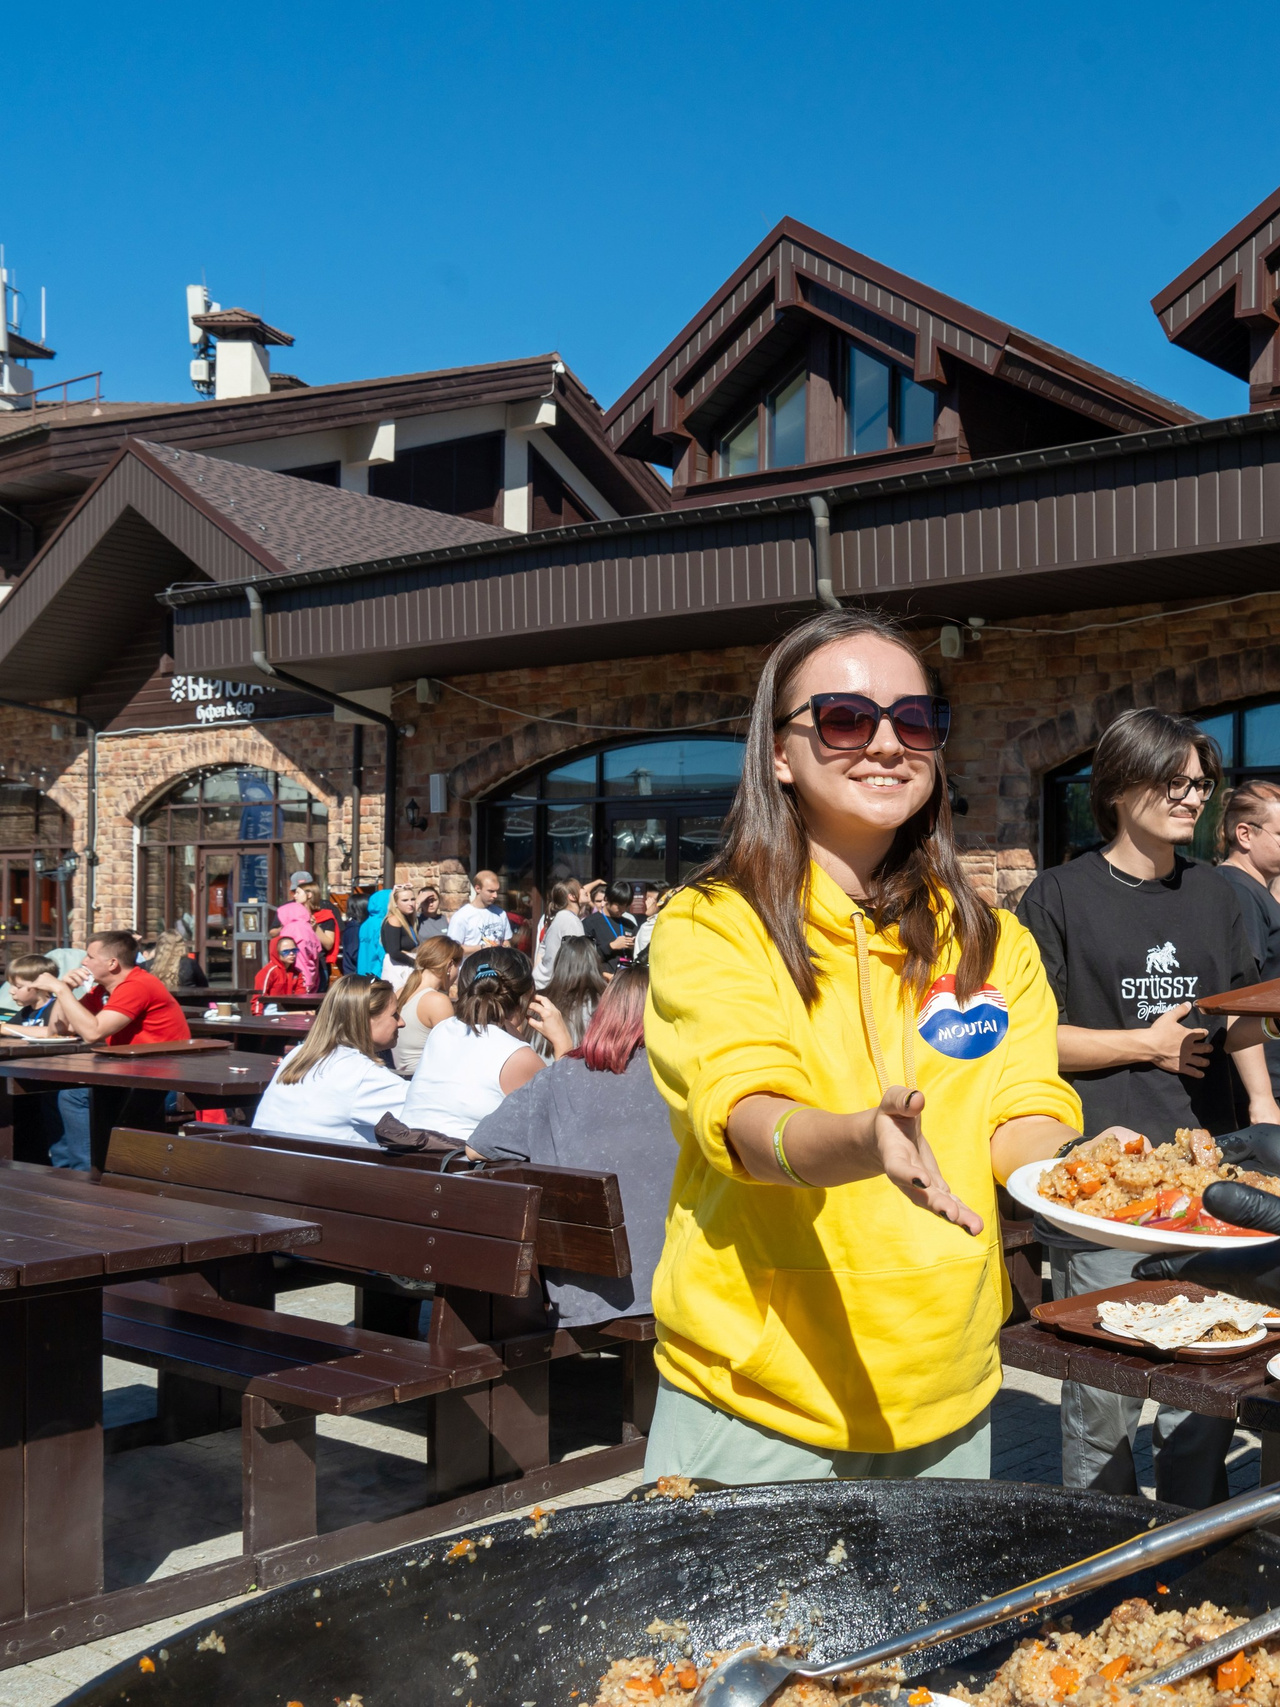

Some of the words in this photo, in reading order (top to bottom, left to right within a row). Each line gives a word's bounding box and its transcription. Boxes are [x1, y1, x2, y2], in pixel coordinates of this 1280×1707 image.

[236, 700, 255, 718] бар
[1121, 975, 1199, 999] STÜSSY
[938, 1019, 998, 1041] MOUTAI
